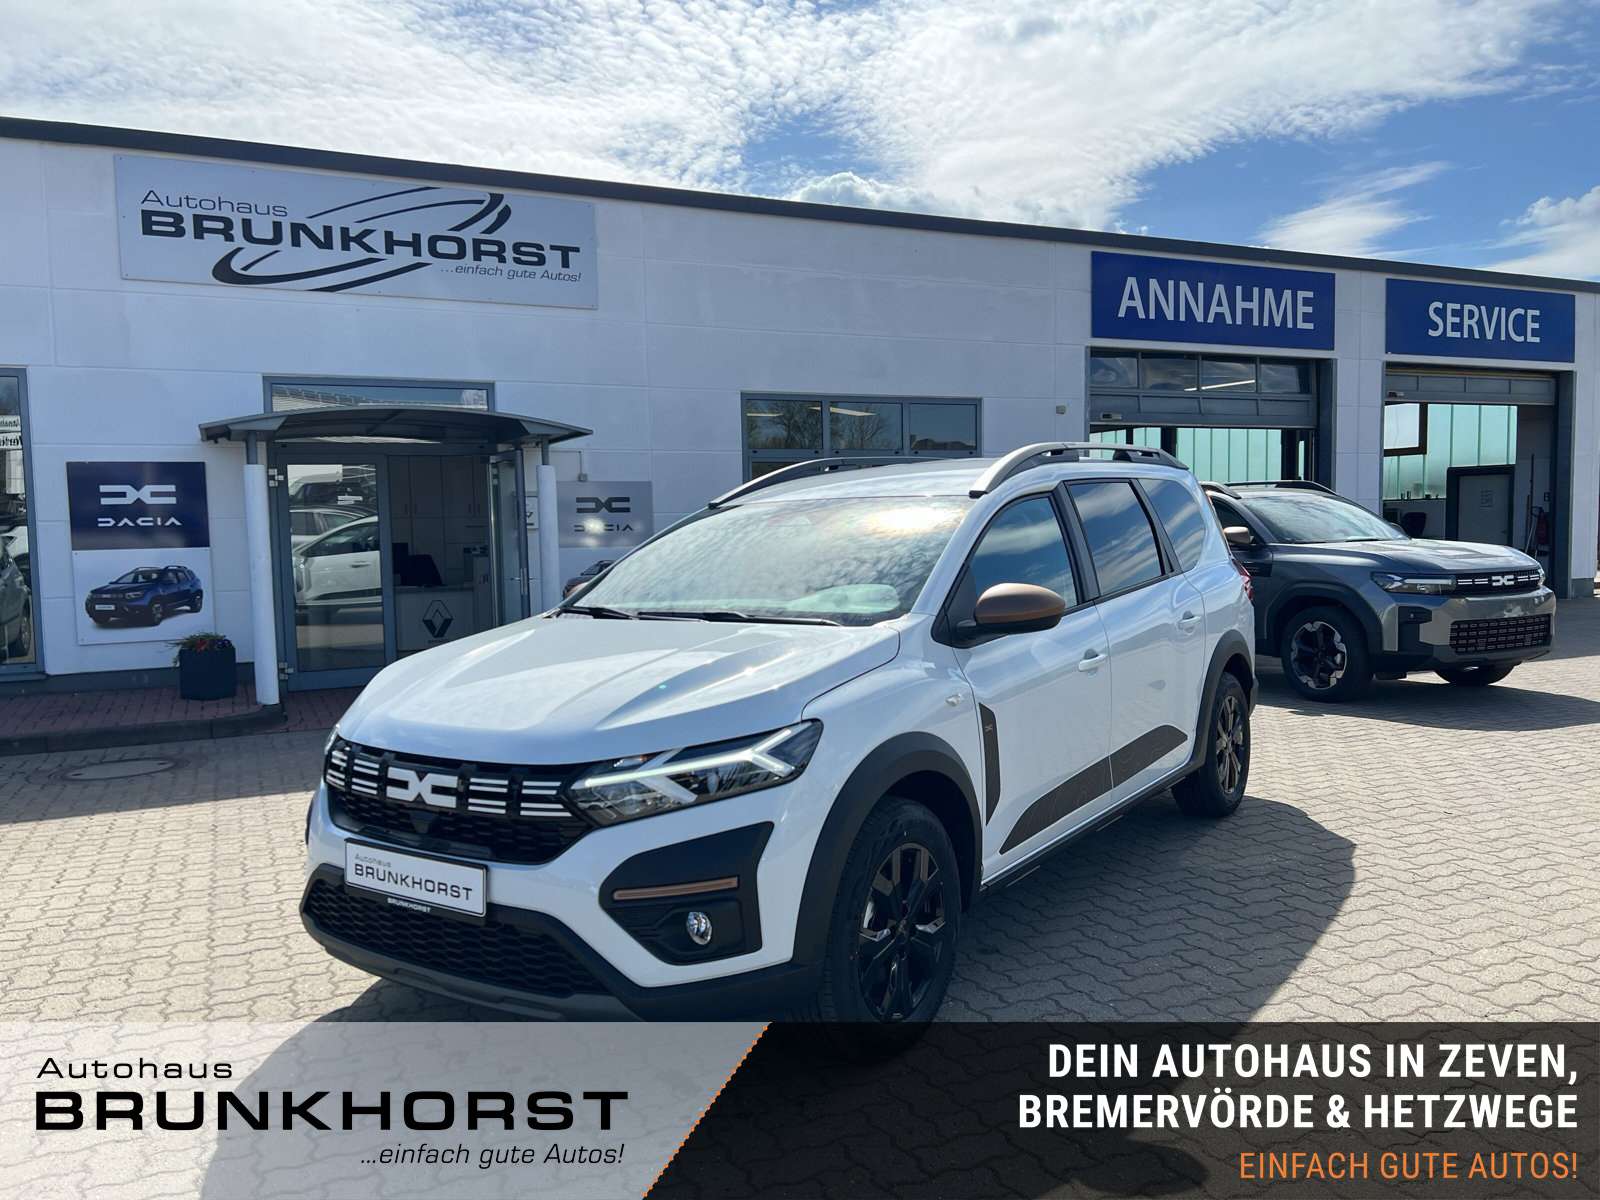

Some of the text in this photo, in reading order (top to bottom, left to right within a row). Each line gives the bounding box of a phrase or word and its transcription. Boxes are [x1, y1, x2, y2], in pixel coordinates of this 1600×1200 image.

[141, 190, 288, 217] Autohaus
[141, 209, 580, 269] BRUNKHORST
[440, 264, 582, 282] ...einfach gute Autos!
[1117, 276, 1314, 330] ANNAHME
[1428, 301, 1541, 343] SERVICE
[97, 517, 182, 527] DACIA
[573, 523, 634, 533] DCIA
[354, 863, 473, 901] BRUNKHORST
